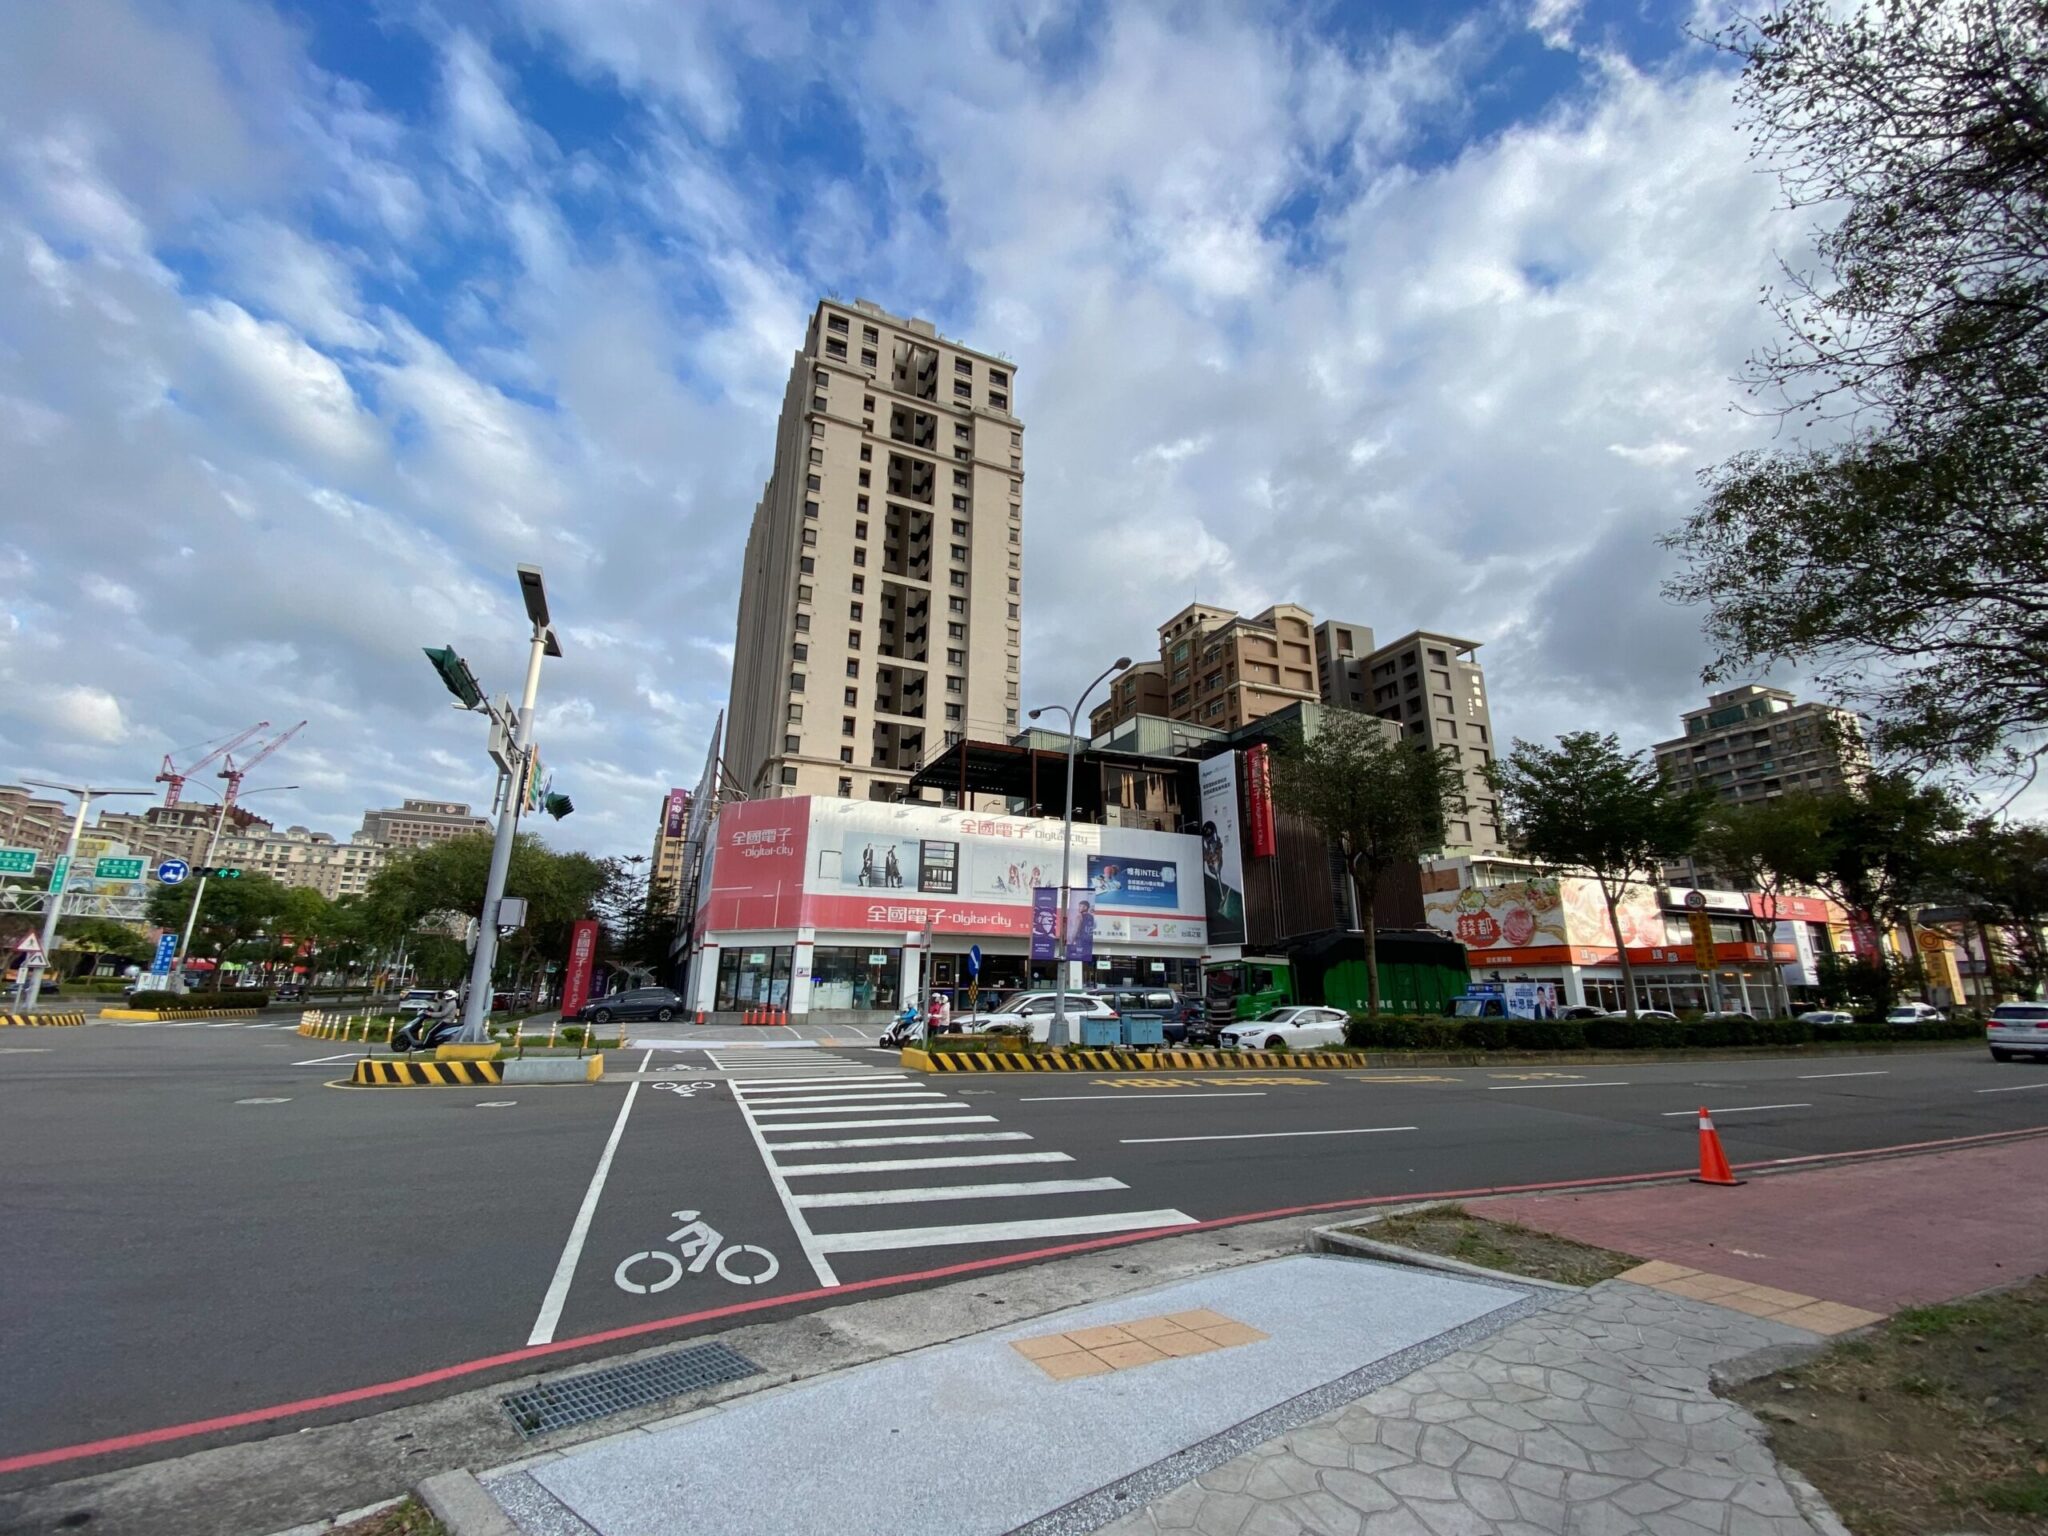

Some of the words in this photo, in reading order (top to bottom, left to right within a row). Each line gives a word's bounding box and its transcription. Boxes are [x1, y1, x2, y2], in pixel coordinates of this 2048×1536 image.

[731, 827, 793, 846] 全國電子
[959, 818, 1031, 839] 全國電子
[867, 905, 947, 925] 全國電子
